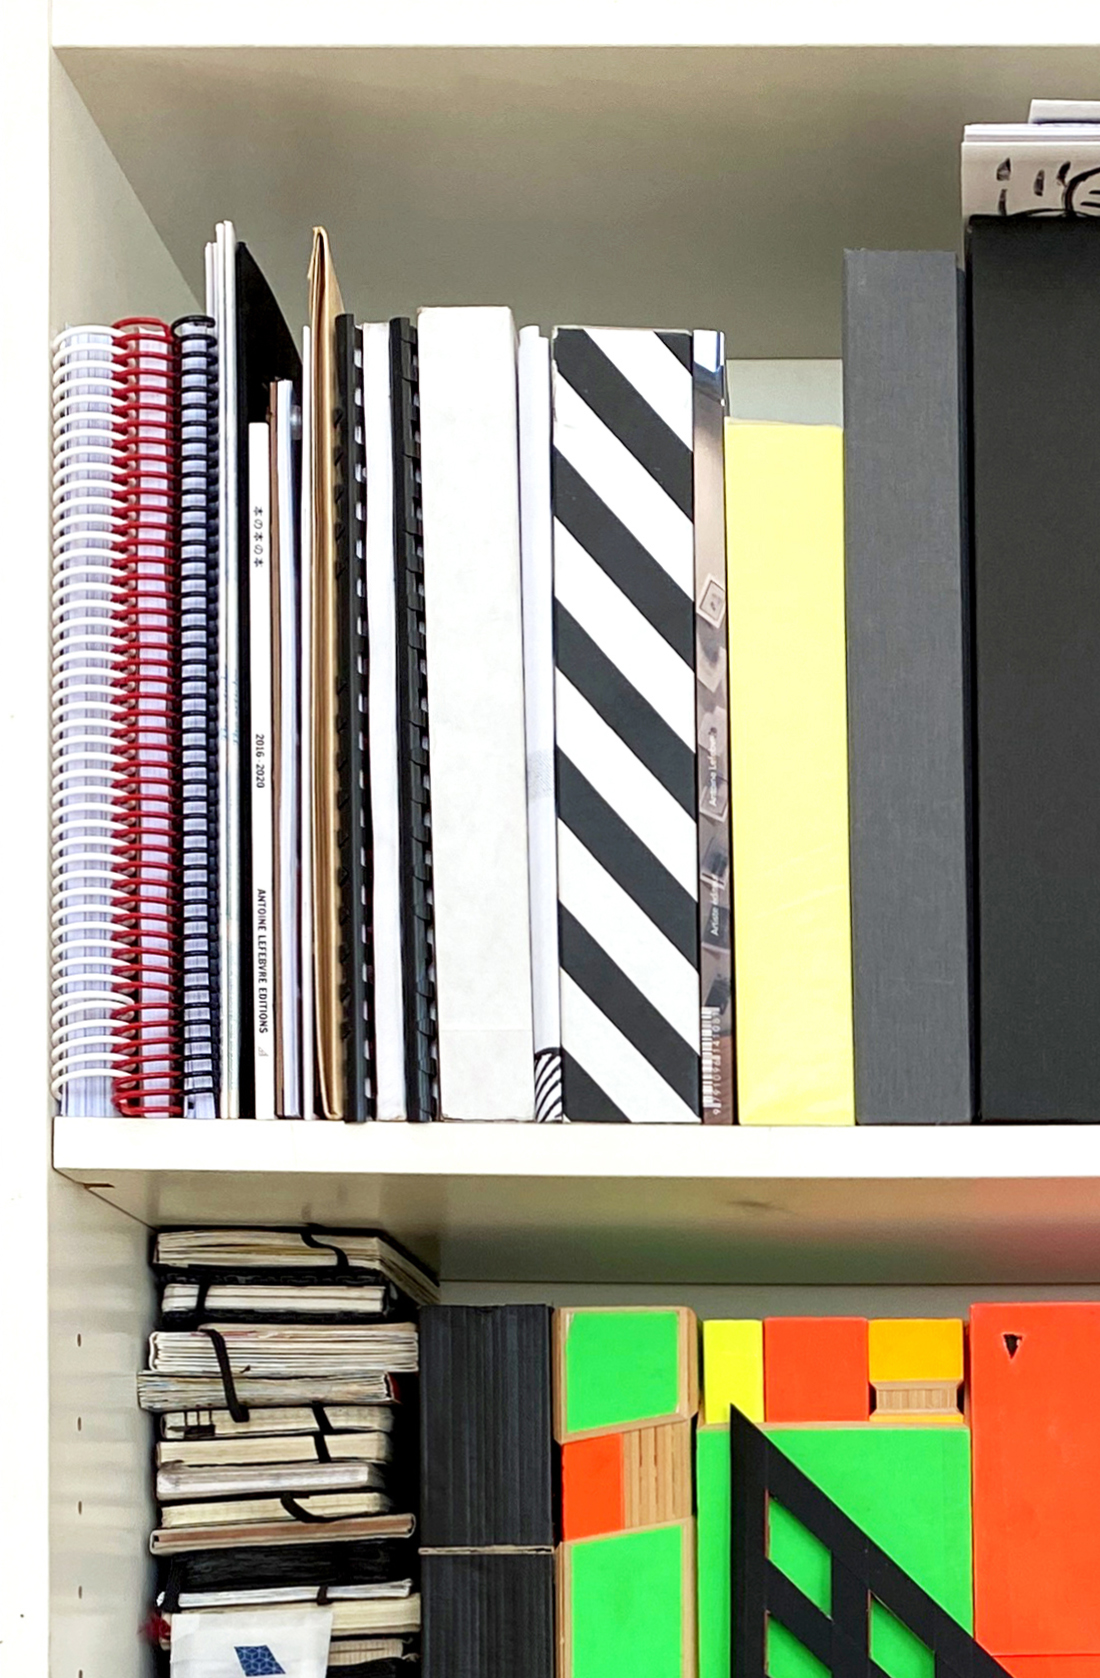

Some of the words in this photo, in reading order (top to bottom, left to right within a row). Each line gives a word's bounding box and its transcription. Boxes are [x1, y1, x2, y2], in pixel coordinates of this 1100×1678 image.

[253, 506, 264, 568] 本の本の本
[255, 733, 265, 758] 2016
[255, 763, 265, 788] 2020
[257, 888, 268, 932] ANTOINE
[257, 934, 268, 984] LEFEBVRE
[257, 987, 269, 1034] EDITIONS
